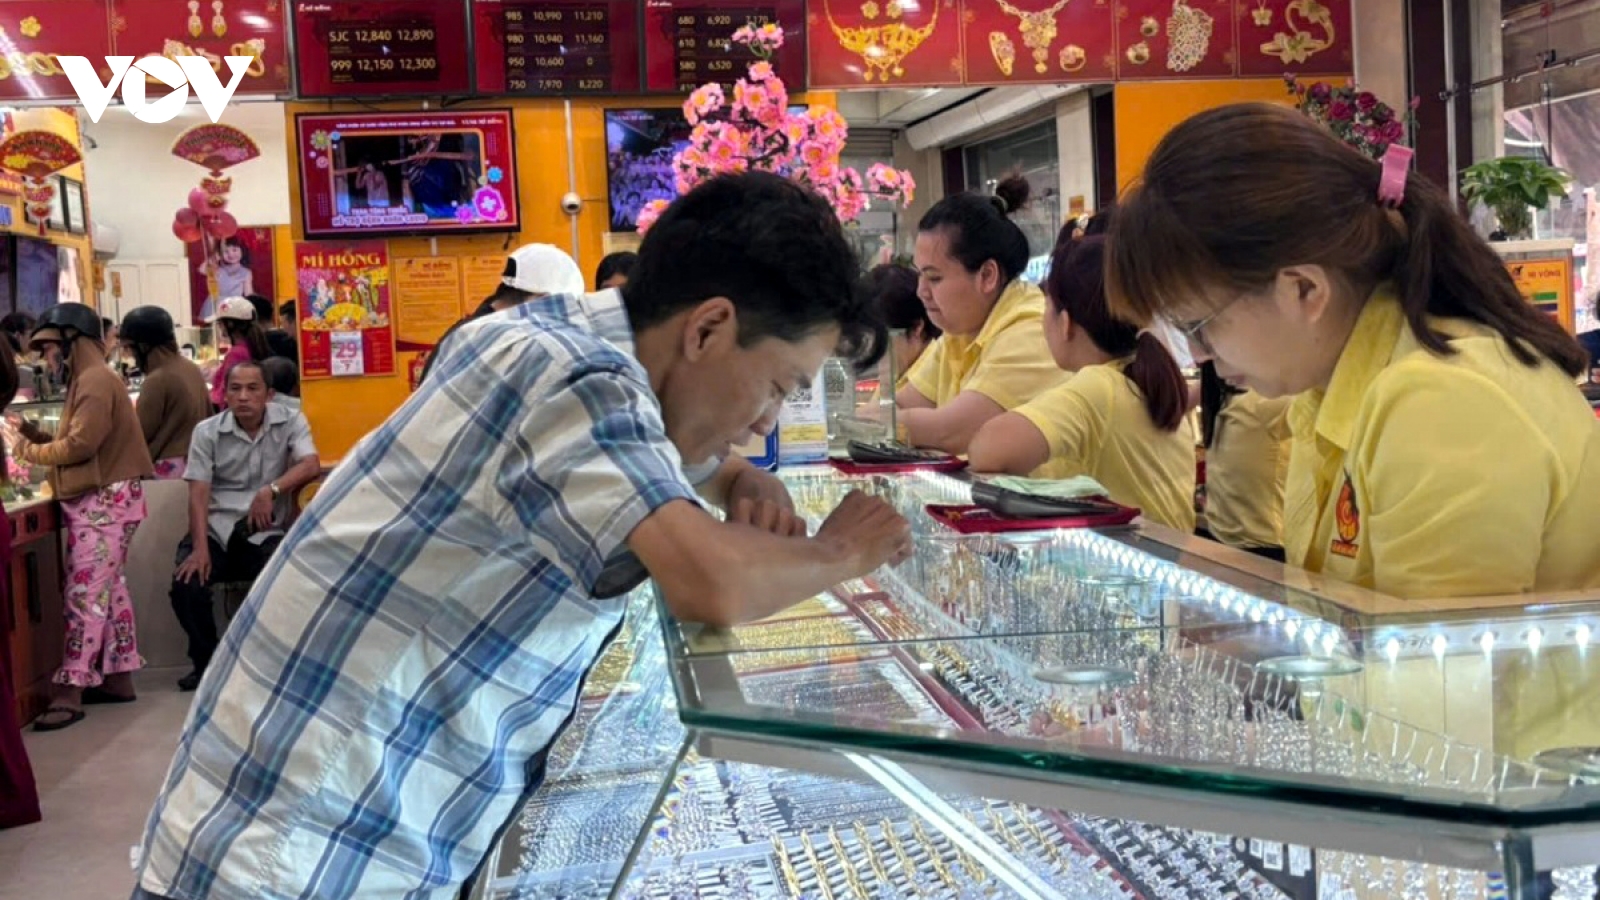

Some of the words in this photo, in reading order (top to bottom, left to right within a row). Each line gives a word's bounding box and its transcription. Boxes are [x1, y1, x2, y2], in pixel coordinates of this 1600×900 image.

[505, 12, 522, 21] 985
[574, 11, 603, 22] 11,210
[678, 16, 695, 25] 680
[329, 31, 349, 42] SJC
[355, 30, 392, 43] 12,840
[397, 29, 434, 42] 12,890
[506, 35, 524, 44] 980
[534, 34, 563, 45] 10,940
[678, 39, 696, 48] 610
[330, 60, 352, 71] 999
[357, 59, 394, 72] 12,150
[399, 58, 436, 72] 12,300
[508, 57, 525, 67] 950
[535, 57, 564, 68] 10,600
[509, 80, 526, 90] 750
[539, 80, 563, 91] 7,970
[335, 340, 357, 359] 29
